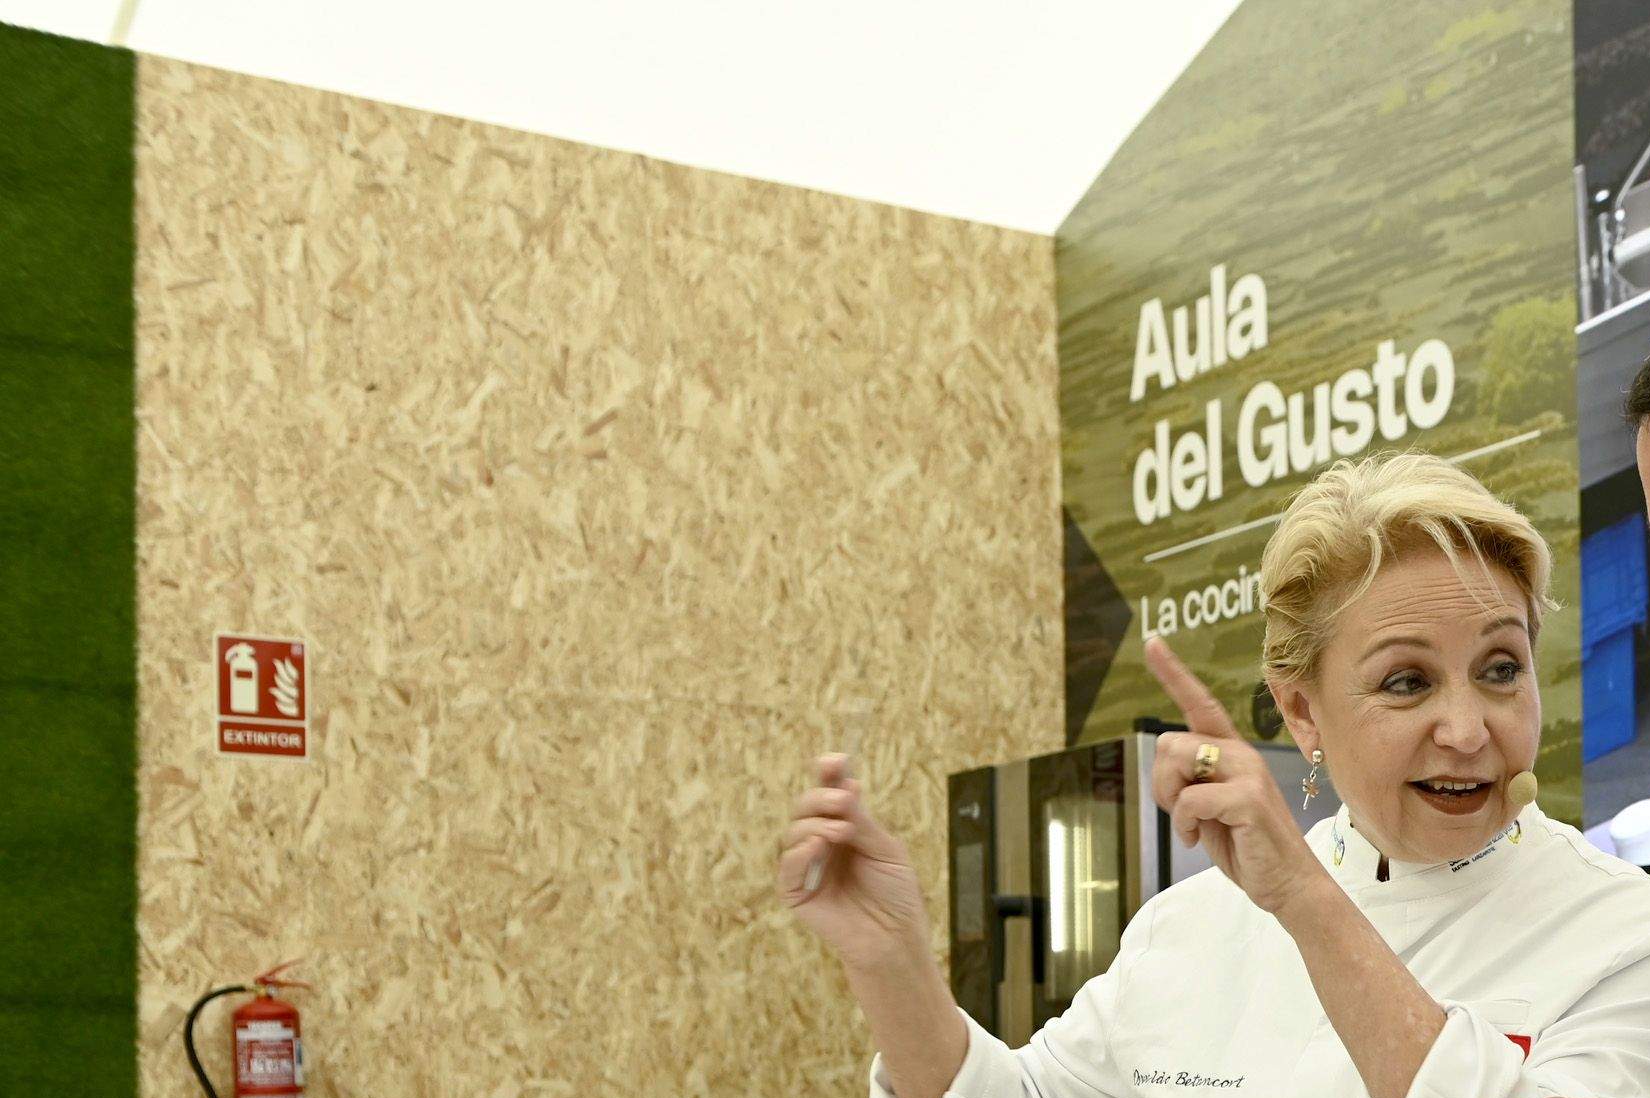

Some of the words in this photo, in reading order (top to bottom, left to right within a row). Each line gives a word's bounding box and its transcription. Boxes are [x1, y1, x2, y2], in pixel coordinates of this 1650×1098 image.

[1130, 264, 1268, 402] Aula
[1133, 399, 1223, 525] del
[1237, 338, 1455, 488] Gusto
[1141, 595, 1178, 641] La
[223, 729, 302, 748] EXTINTOR
